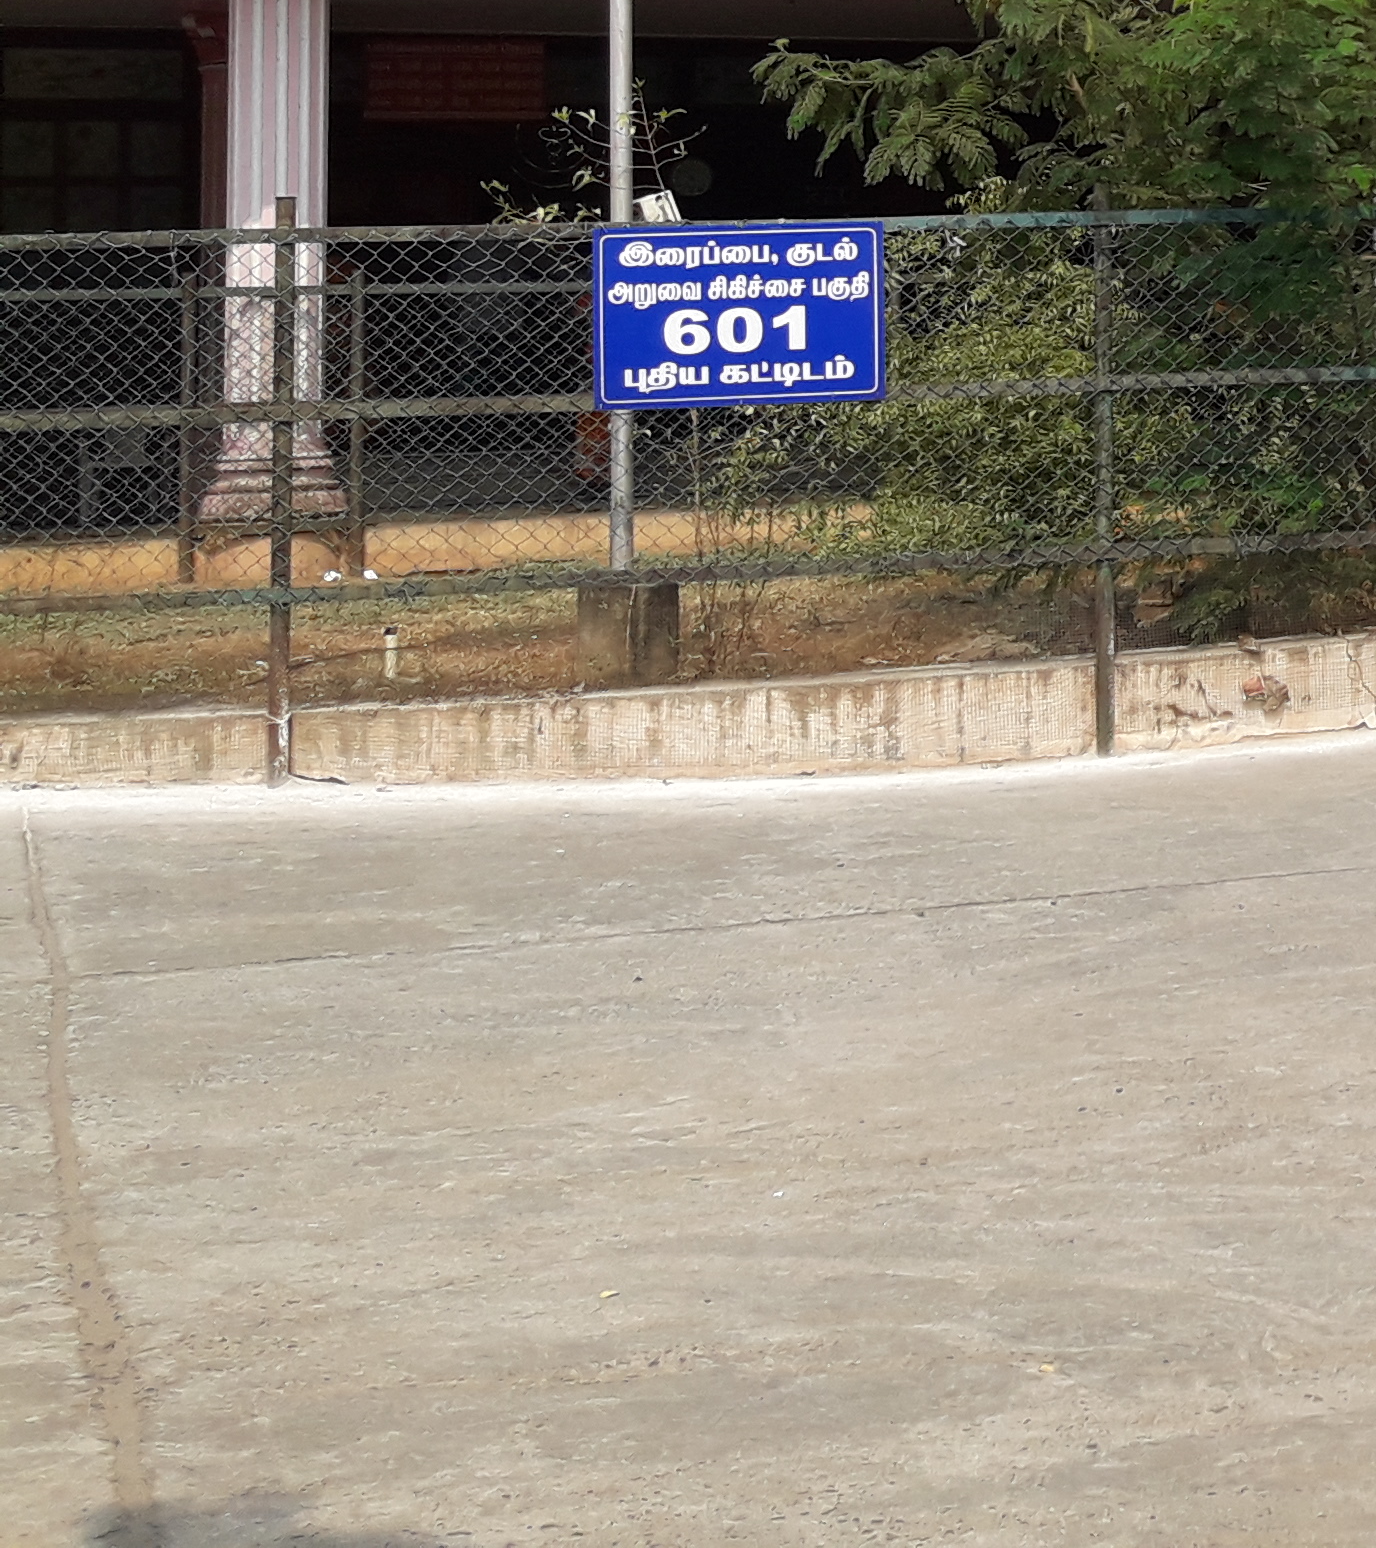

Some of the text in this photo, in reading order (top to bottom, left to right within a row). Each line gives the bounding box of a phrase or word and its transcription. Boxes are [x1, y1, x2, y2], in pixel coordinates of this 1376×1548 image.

[618, 237, 858, 269] இரைப்பை, குடல்
[608, 271, 870, 309] அறுவை சிகிச்சை பகுதி
[663, 305, 807, 355] 601
[624, 355, 855, 394] புதிய கட்டிடம்
